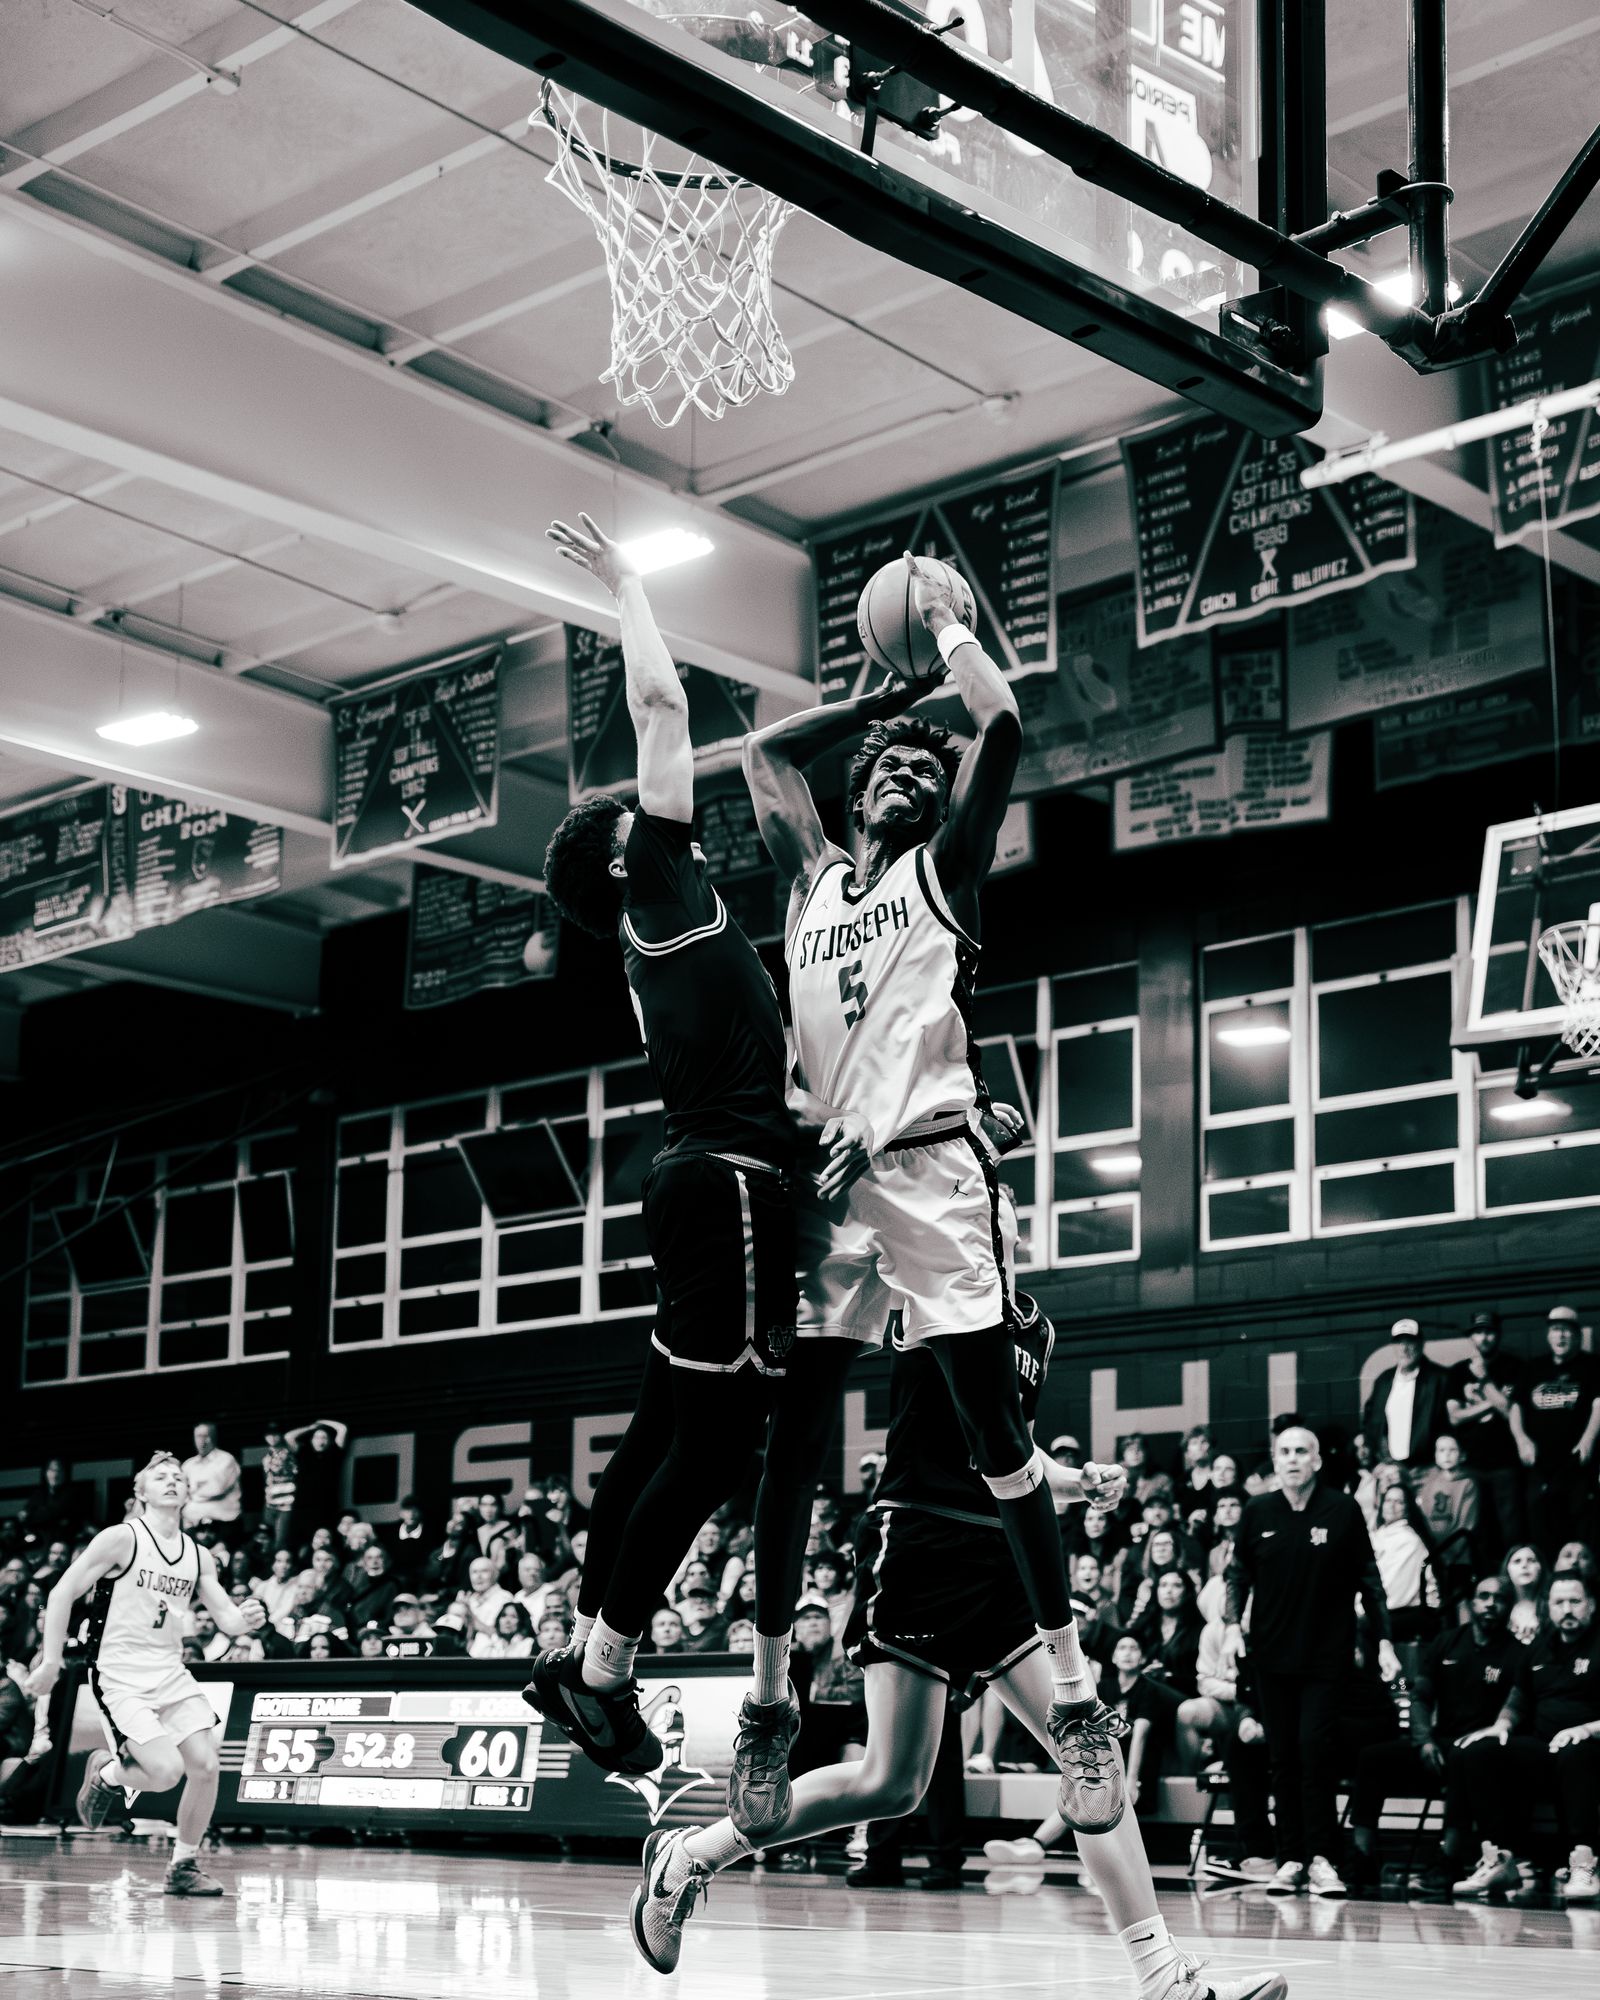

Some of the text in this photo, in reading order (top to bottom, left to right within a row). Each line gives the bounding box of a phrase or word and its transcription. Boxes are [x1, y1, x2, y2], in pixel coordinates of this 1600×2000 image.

[1229, 493, 1312, 534] CHAMPIONS
[1231, 475, 1304, 511] SOFTBAL
[838, 959, 869, 1031] 5
[1014, 1343, 1040, 1387] TRE
[152, 1599, 168, 1629] 3
[256, 1698, 362, 1716] NOTRE DAME
[262, 1729, 319, 1773] 55
[342, 1732, 415, 1769] 52.8
[459, 1730, 519, 1778] 60
